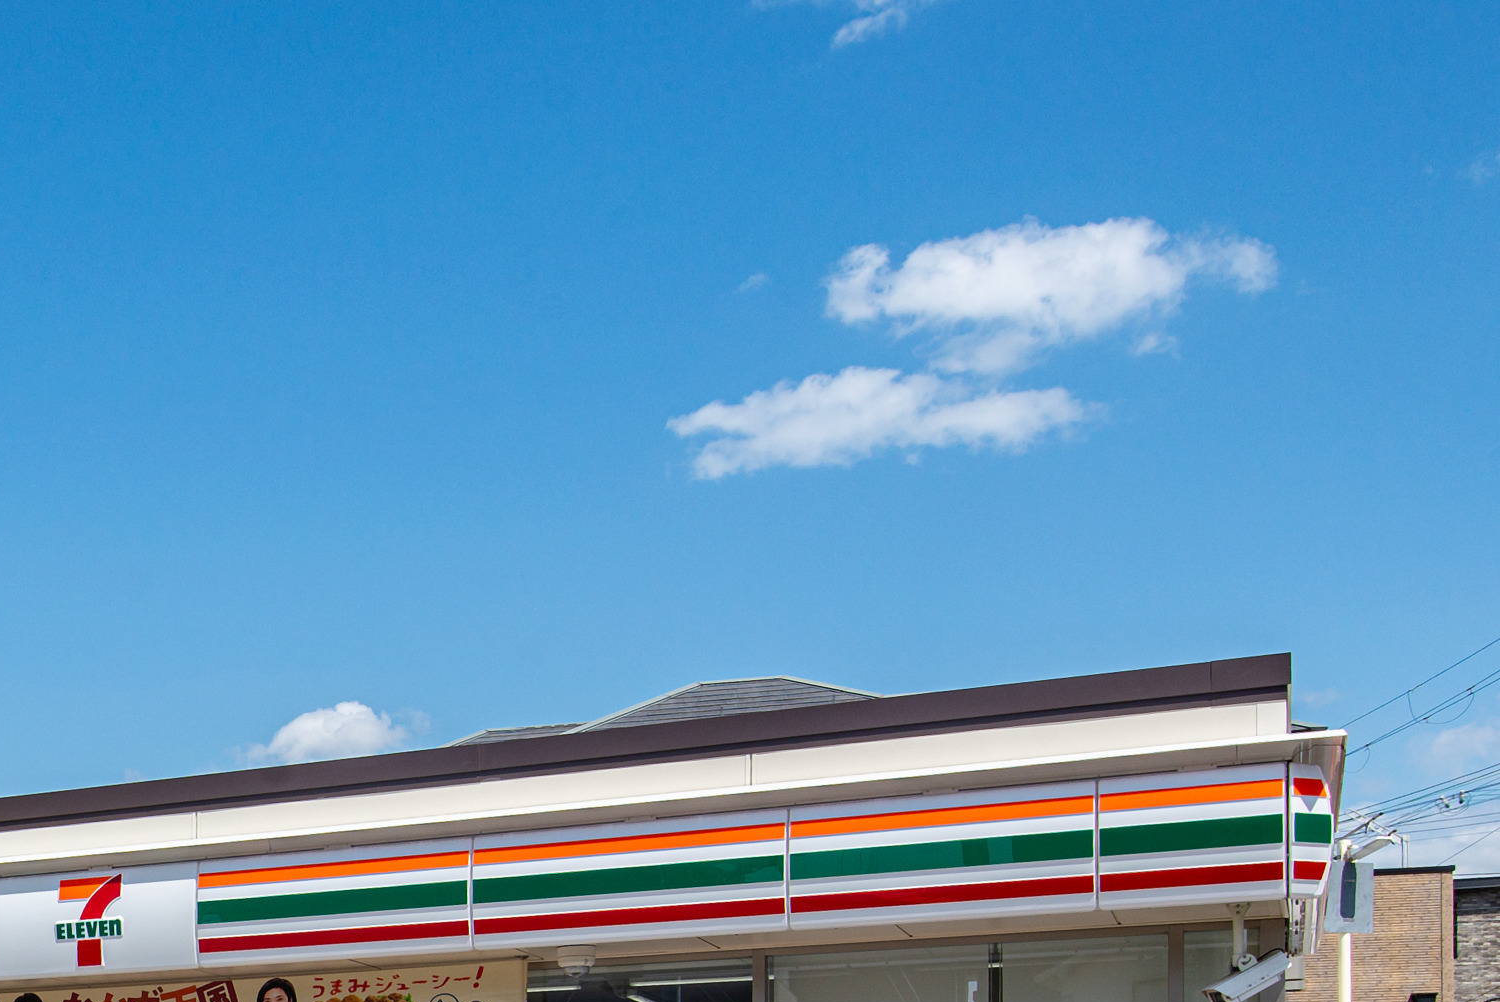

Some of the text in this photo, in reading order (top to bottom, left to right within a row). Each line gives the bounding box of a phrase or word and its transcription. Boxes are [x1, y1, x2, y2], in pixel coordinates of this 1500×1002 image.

[58, 874, 122, 967] 7
[312, 966, 484, 999] うまみジューシー!
